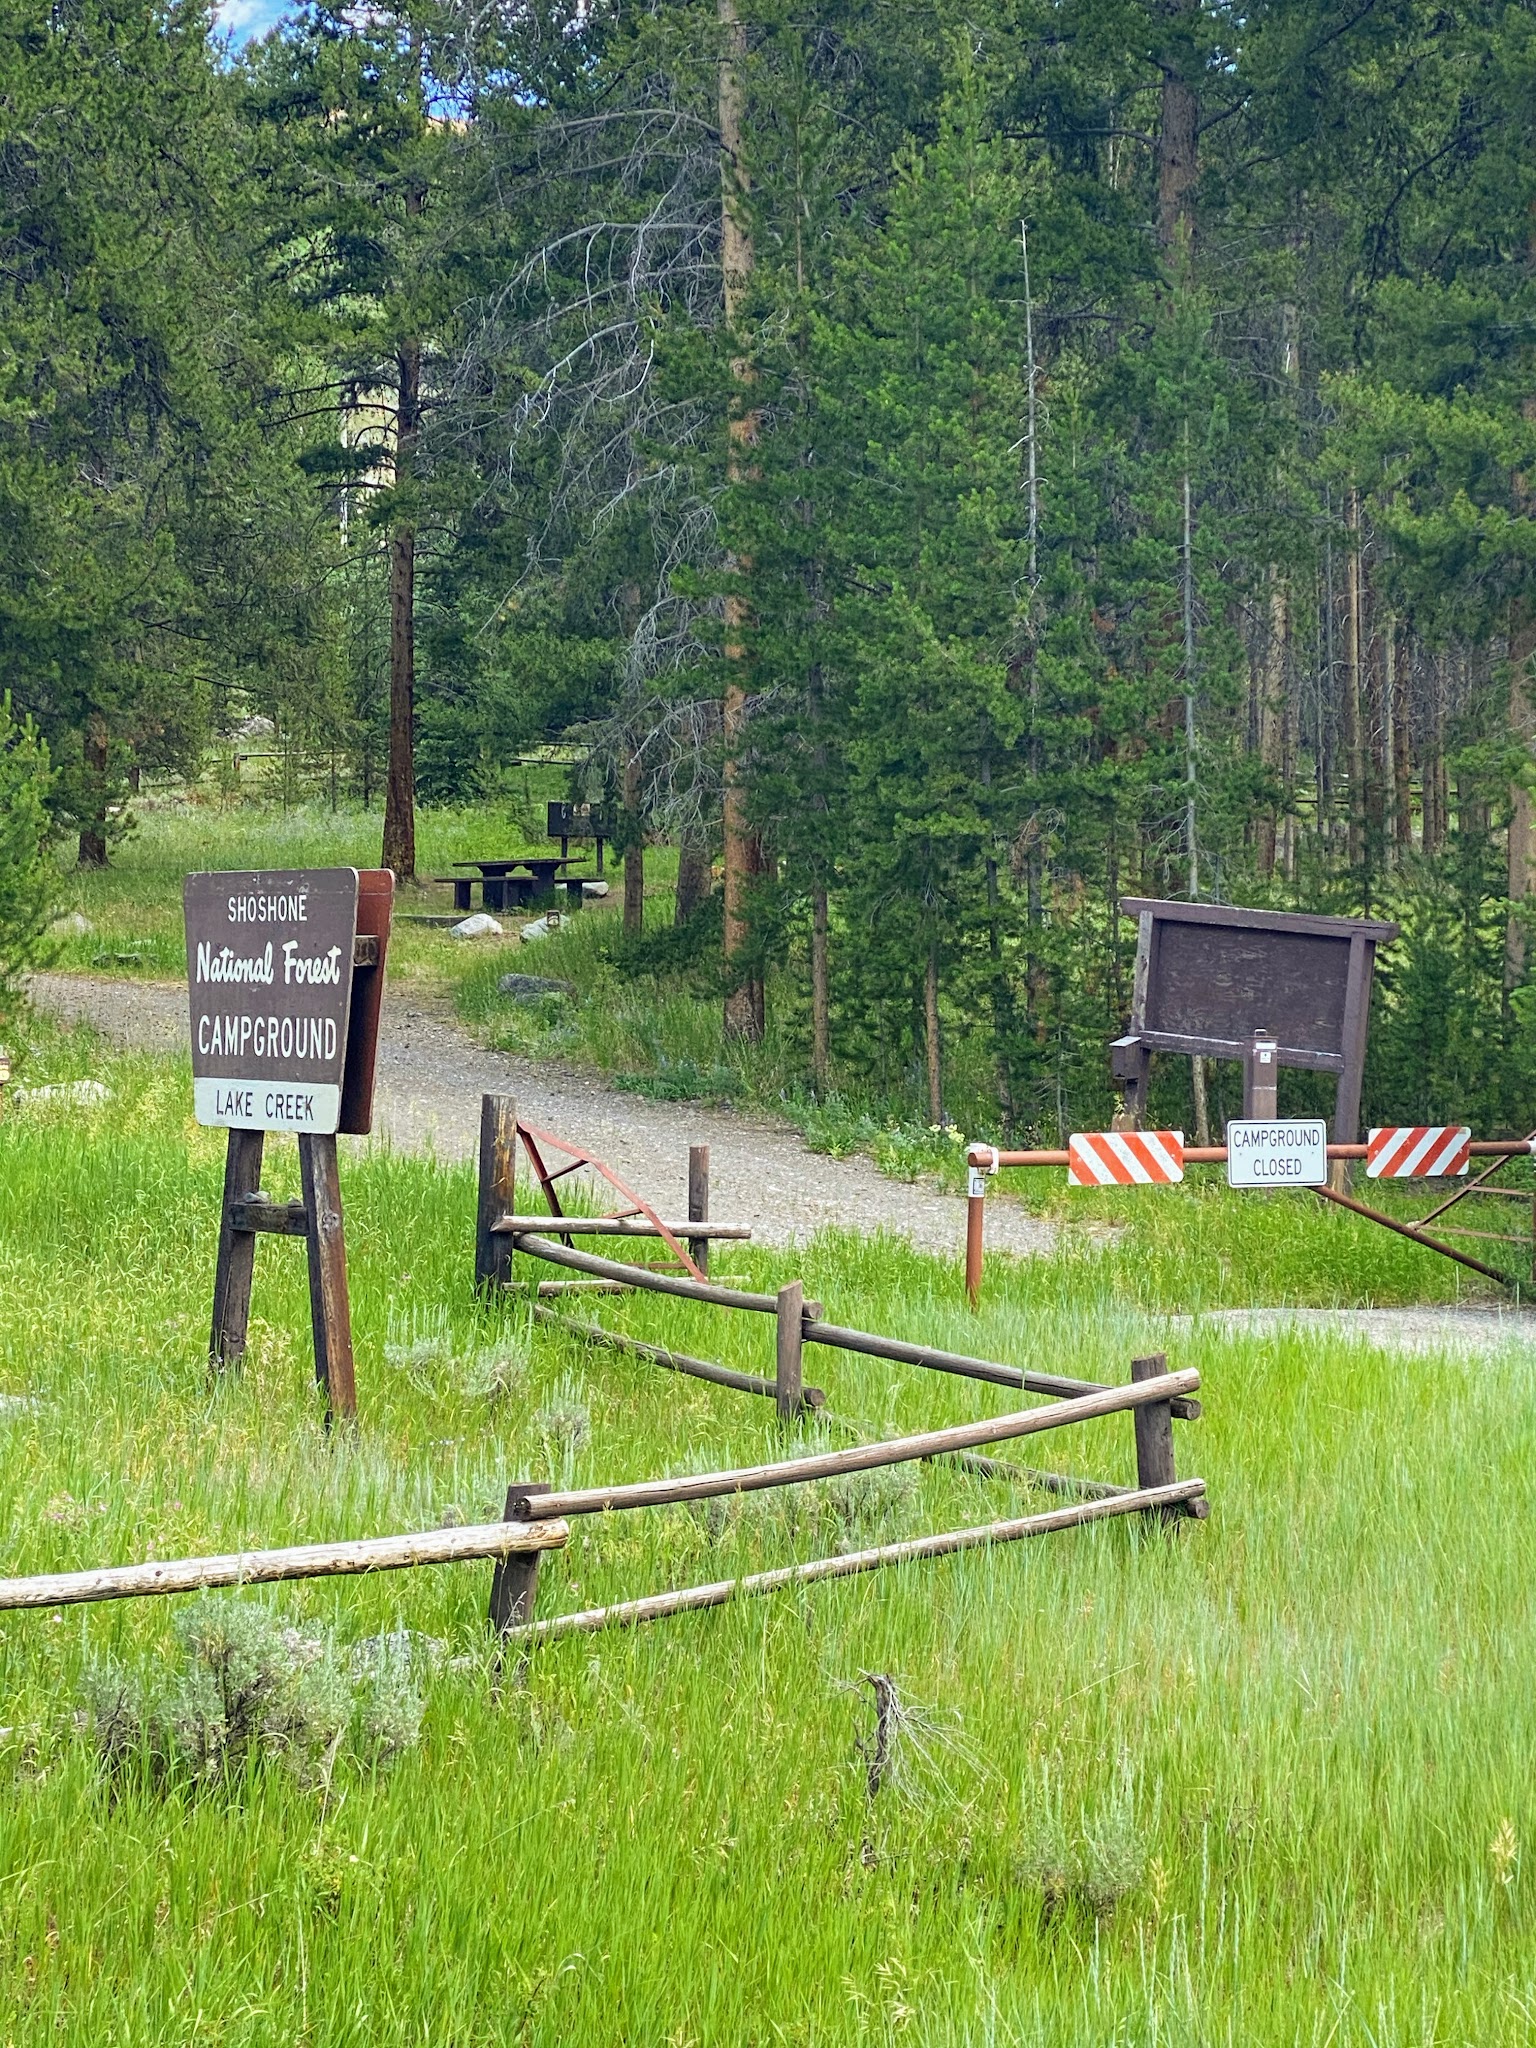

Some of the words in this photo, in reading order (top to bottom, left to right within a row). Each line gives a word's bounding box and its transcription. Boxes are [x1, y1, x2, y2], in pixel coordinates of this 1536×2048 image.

[228, 894, 308, 922] SHOSHONE
[196, 941, 274, 985] National
[282, 940, 342, 985] Forest
[198, 1014, 337, 1060] CAMPGROUND
[216, 1089, 253, 1117] LAKE
[265, 1092, 314, 1121] CREEK
[1233, 1129, 1320, 1148] CAMPGROUND
[1253, 1158, 1302, 1176] CLOSED
